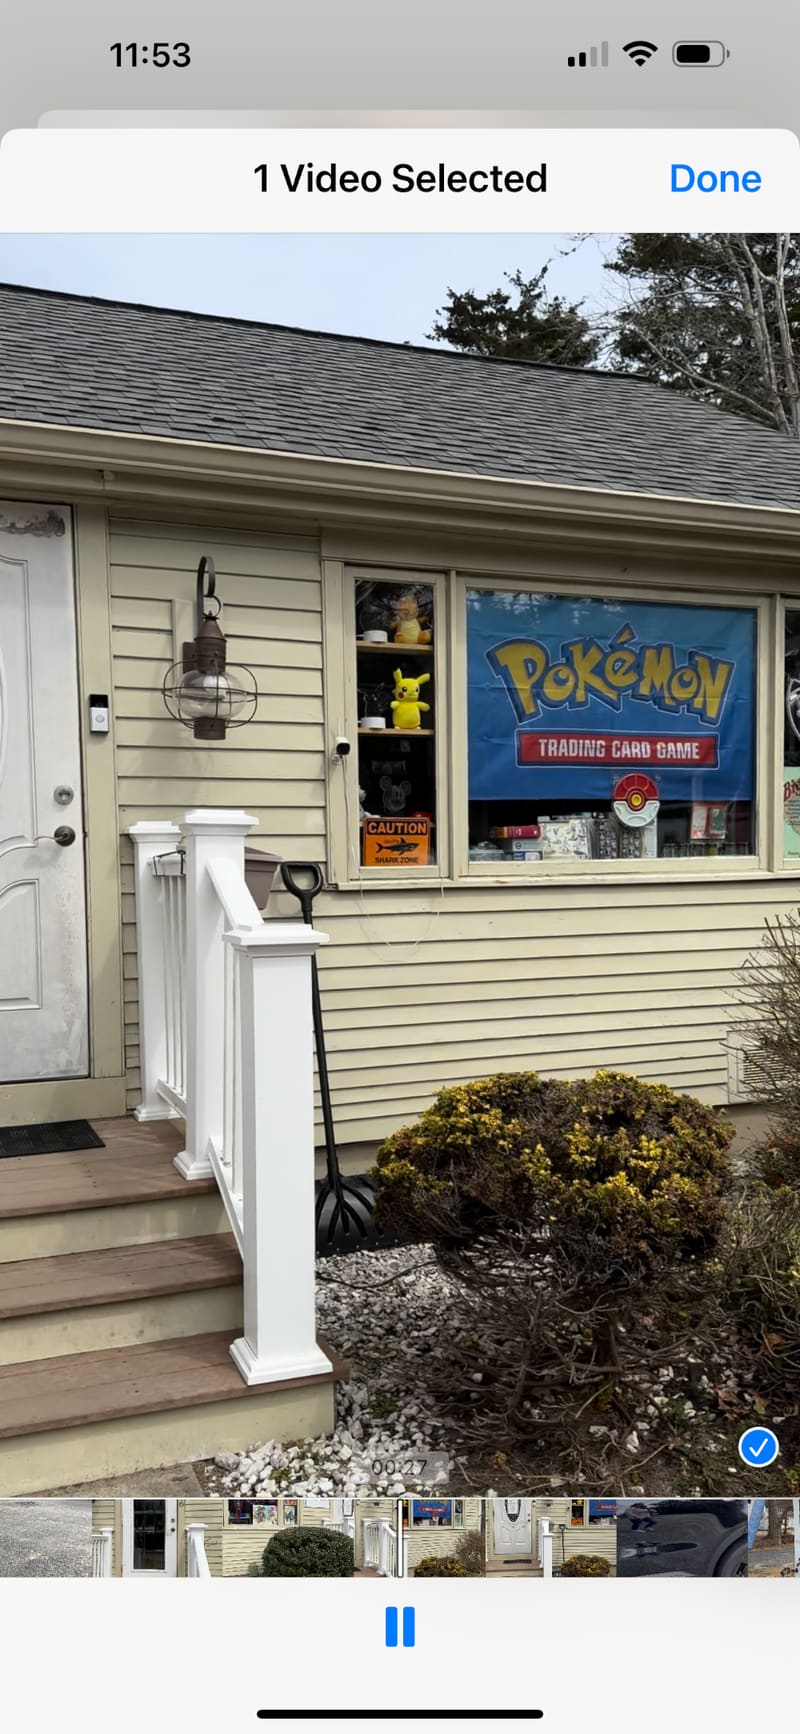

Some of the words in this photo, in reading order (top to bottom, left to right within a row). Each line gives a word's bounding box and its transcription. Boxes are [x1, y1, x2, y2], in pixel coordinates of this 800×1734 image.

[538, 738, 606, 758] TRADING
[611, 740, 651, 759] CARD
[656, 742, 700, 760] GAME
[368, 822, 427, 834] CAUTION
[375, 856, 399, 864] SHARK
[400, 856, 419, 864] ZONE
